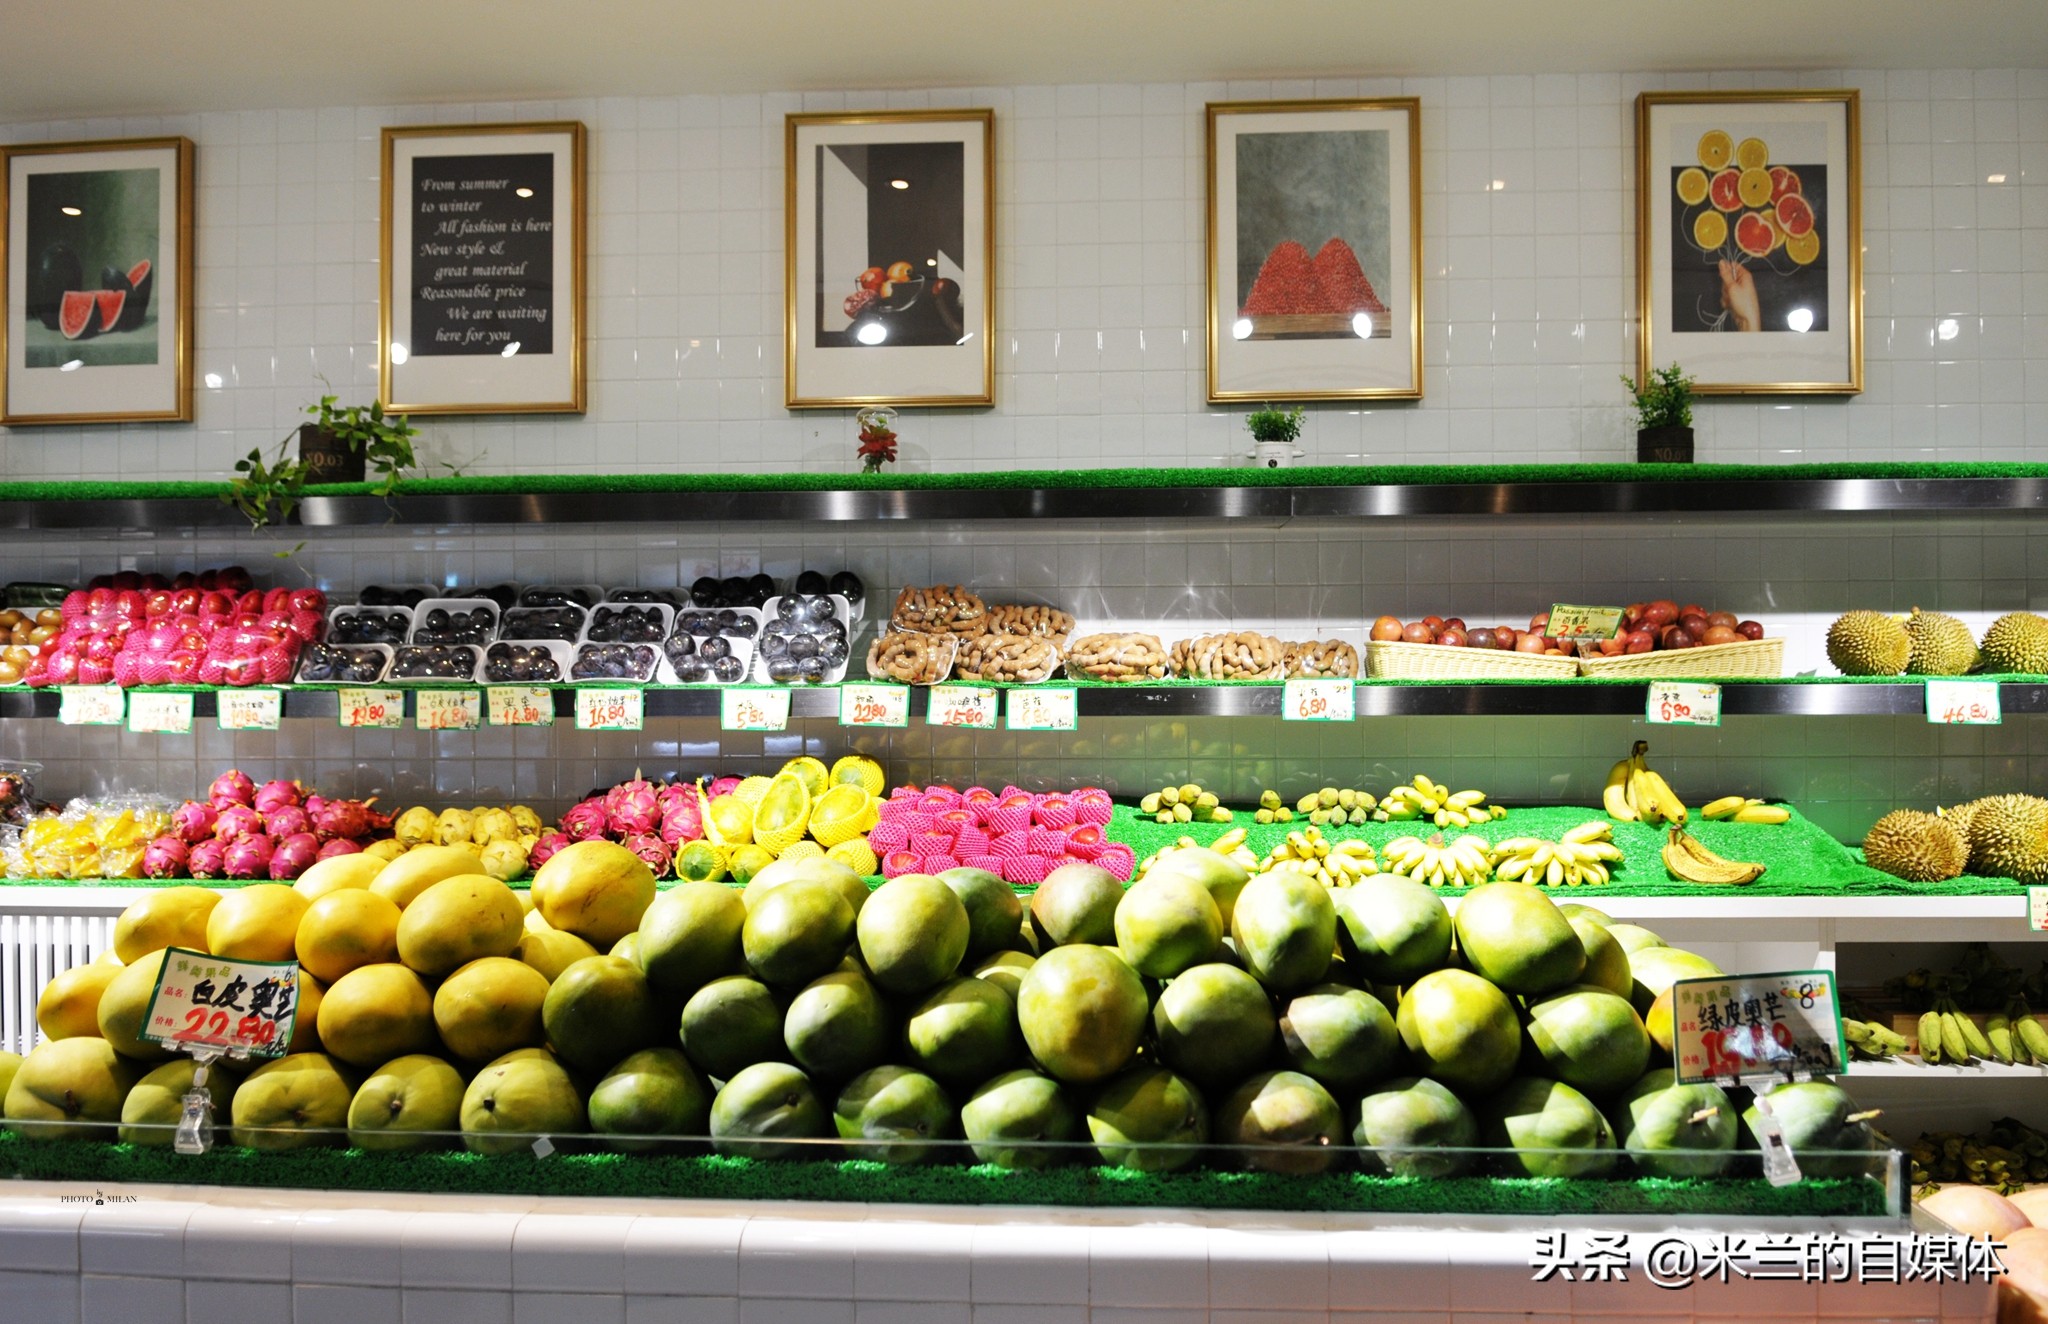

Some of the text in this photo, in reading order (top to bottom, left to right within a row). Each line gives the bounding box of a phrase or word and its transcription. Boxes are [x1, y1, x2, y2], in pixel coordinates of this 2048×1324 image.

[421, 179, 509, 191] From summer
[421, 200, 482, 213] to winter
[434, 217, 552, 238] All fashion is here
[420, 241, 505, 259] New style &
[434, 261, 528, 281] great material
[420, 284, 526, 301] Reasonable price
[446, 306, 547, 322] We are waiting
[435, 328, 511, 345] here for you
[504, 707, 539, 726] 16.80
[589, 705, 625, 728] 16.80
[1299, 697, 1327, 717] 6.80
[1943, 703, 1988, 723] 46.80
[1799, 982, 1815, 1010] 8
[1698, 991, 1787, 1033] 绿皮奥芒
